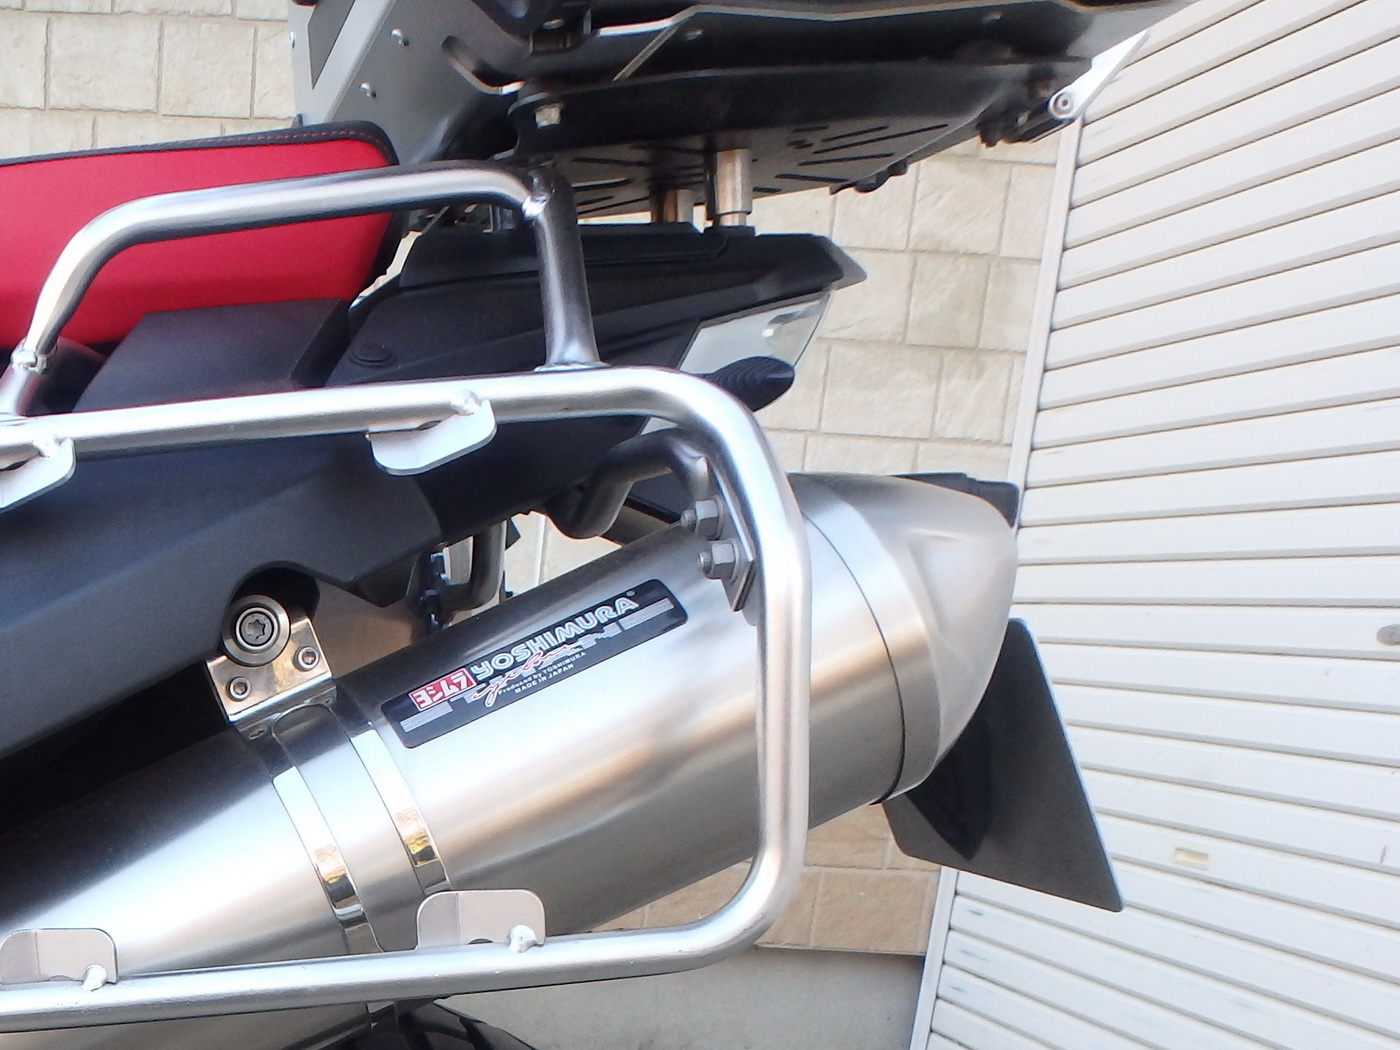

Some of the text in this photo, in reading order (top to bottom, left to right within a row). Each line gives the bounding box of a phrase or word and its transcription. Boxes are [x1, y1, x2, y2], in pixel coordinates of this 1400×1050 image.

[470, 596, 639, 681] YOSHIMURA
[514, 681, 538, 694] MADE
[547, 663, 574, 683] JAPAN
[542, 651, 586, 675] YOSHIMURA
[410, 672, 473, 710] ヨシムラ
